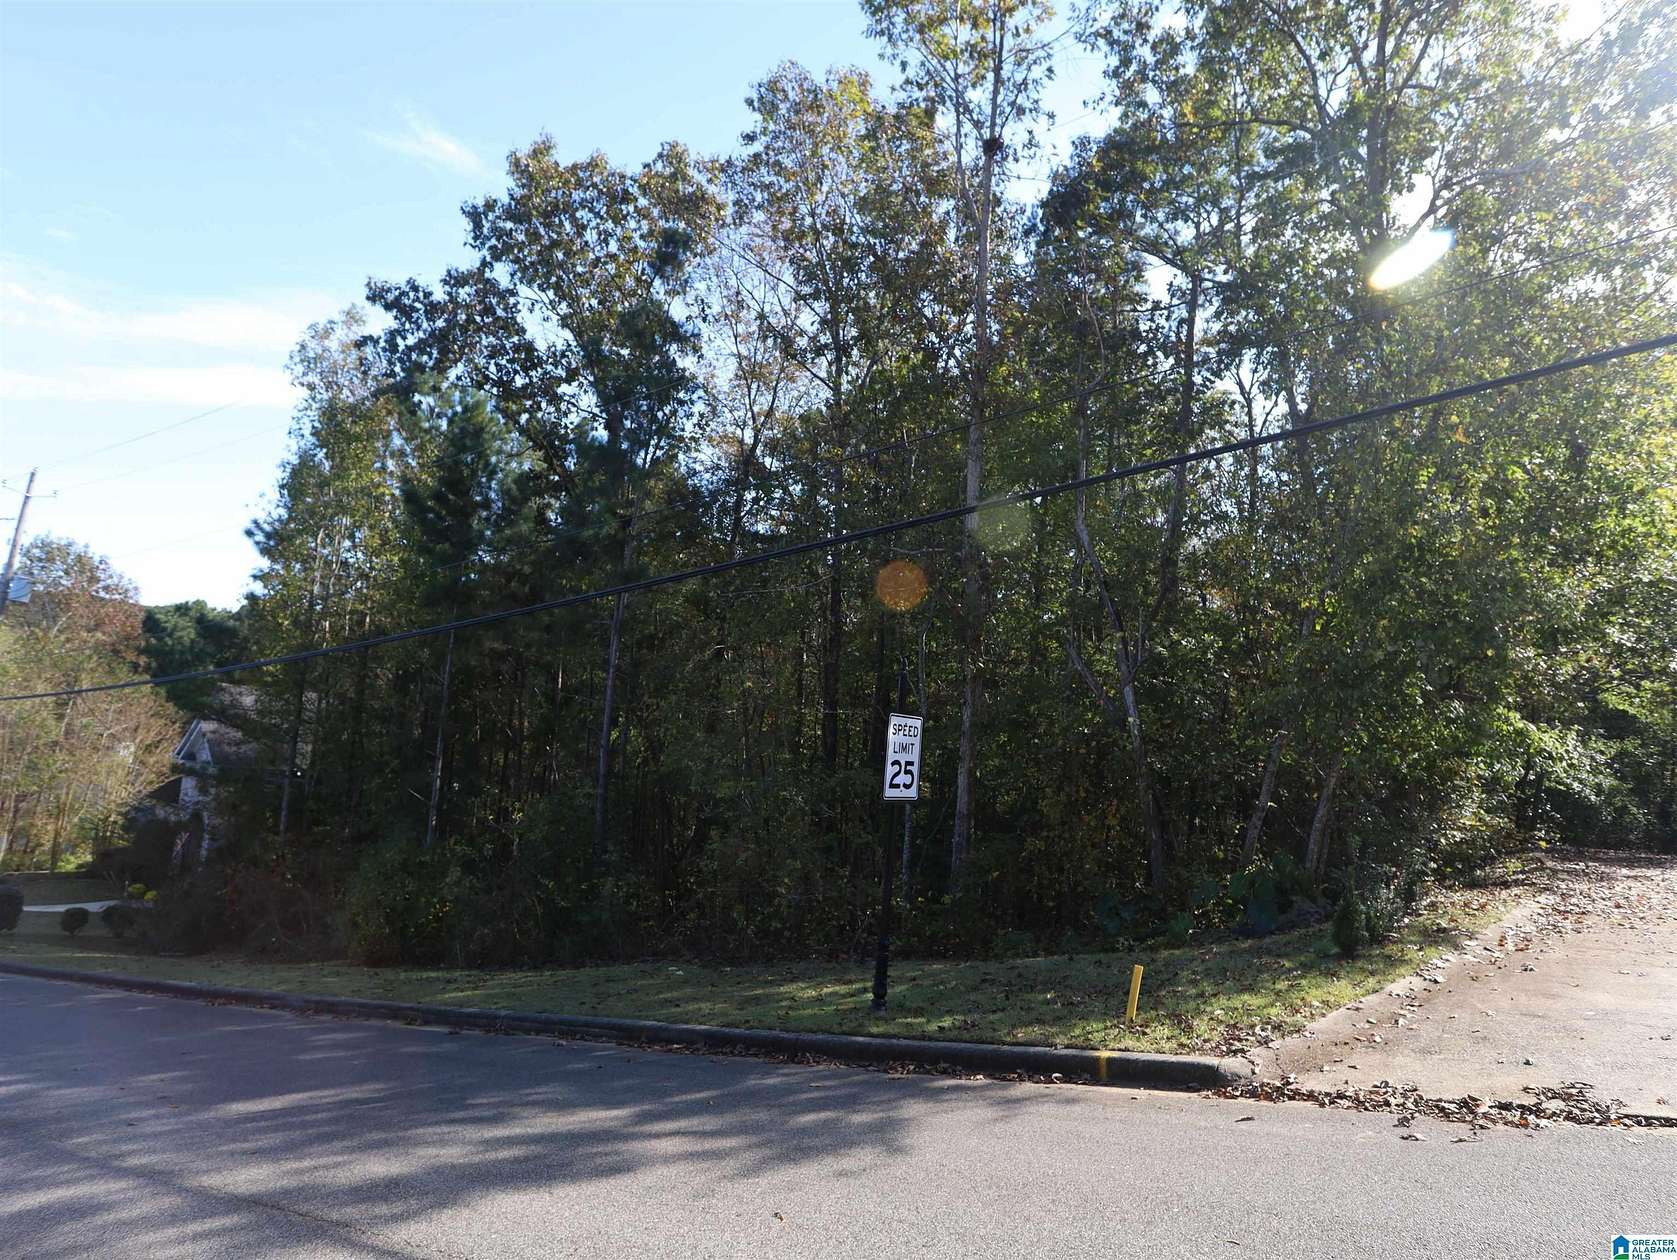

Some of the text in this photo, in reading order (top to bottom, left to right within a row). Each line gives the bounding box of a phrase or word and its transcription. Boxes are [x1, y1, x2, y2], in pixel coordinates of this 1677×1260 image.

[892, 723, 919, 738] SPEED
[893, 741, 915, 755] LIMIT
[888, 759, 915, 790] 25
